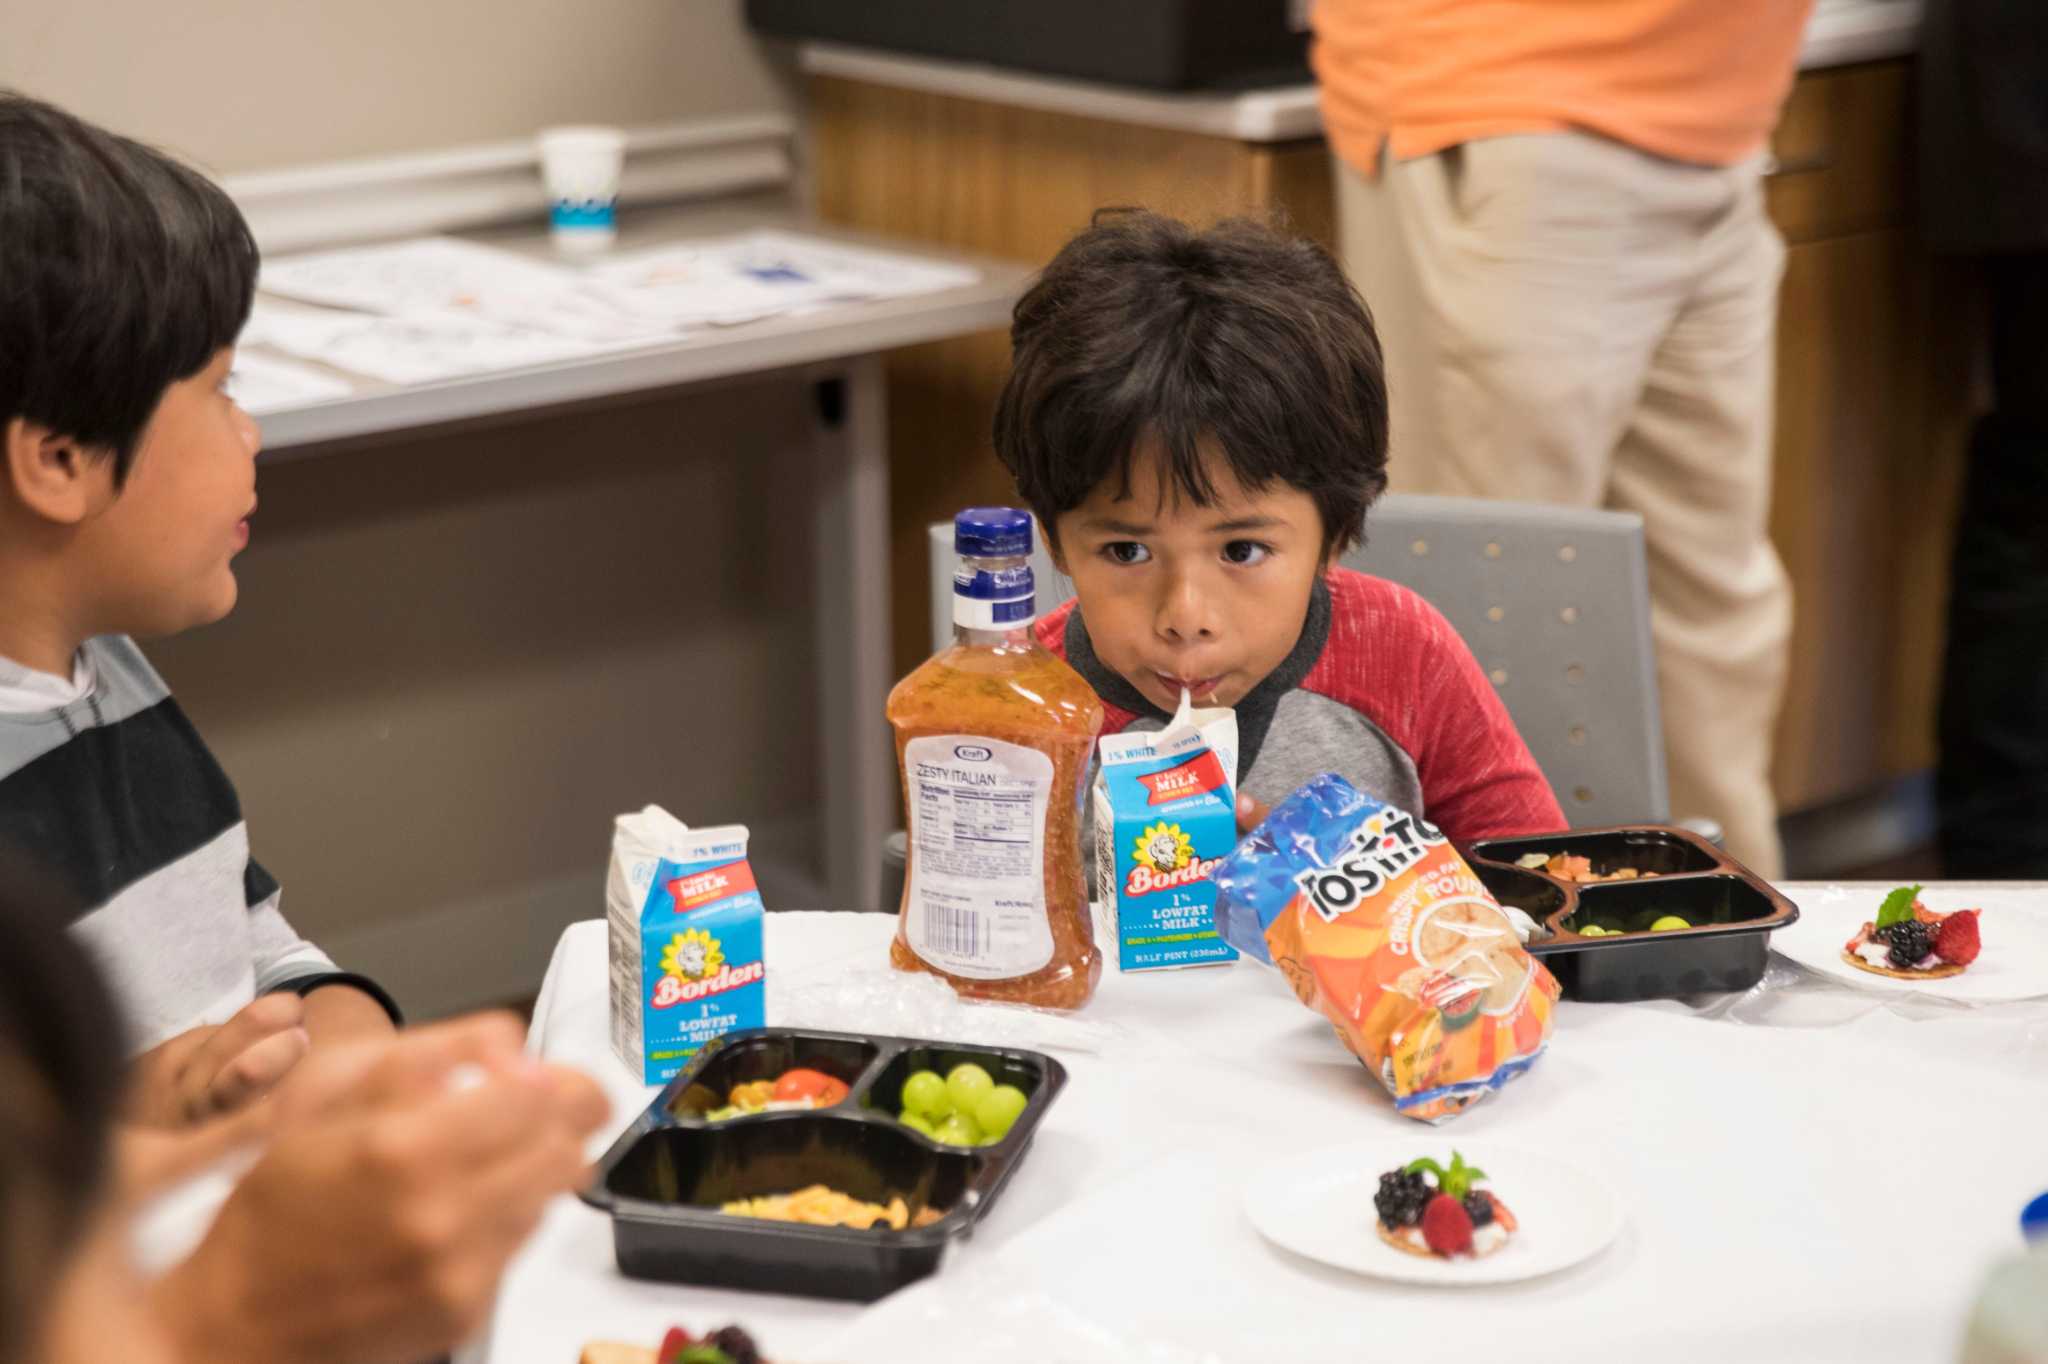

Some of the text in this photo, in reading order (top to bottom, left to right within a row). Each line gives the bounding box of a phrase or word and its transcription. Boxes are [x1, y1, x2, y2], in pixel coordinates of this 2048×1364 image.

[962, 749, 984, 758] Kraft
[1125, 746, 1157, 759] WHITE
[916, 763, 950, 779] ZESTY
[951, 770, 997, 786] ITALIAN
[1156, 772, 1200, 793] MILK
[711, 842, 742, 855] WHITE
[681, 876, 729, 898] MILK
[1172, 893, 1191, 907] 1%
[1152, 904, 1209, 920] LOWFAT
[1162, 917, 1200, 931] MILK
[1135, 951, 1162, 963] HALF
[1164, 950, 1188, 961] PINT
[653, 961, 764, 1007] Borden
[701, 1003, 720, 1018] 1%
[679, 1013, 738, 1033] LOWFAT
